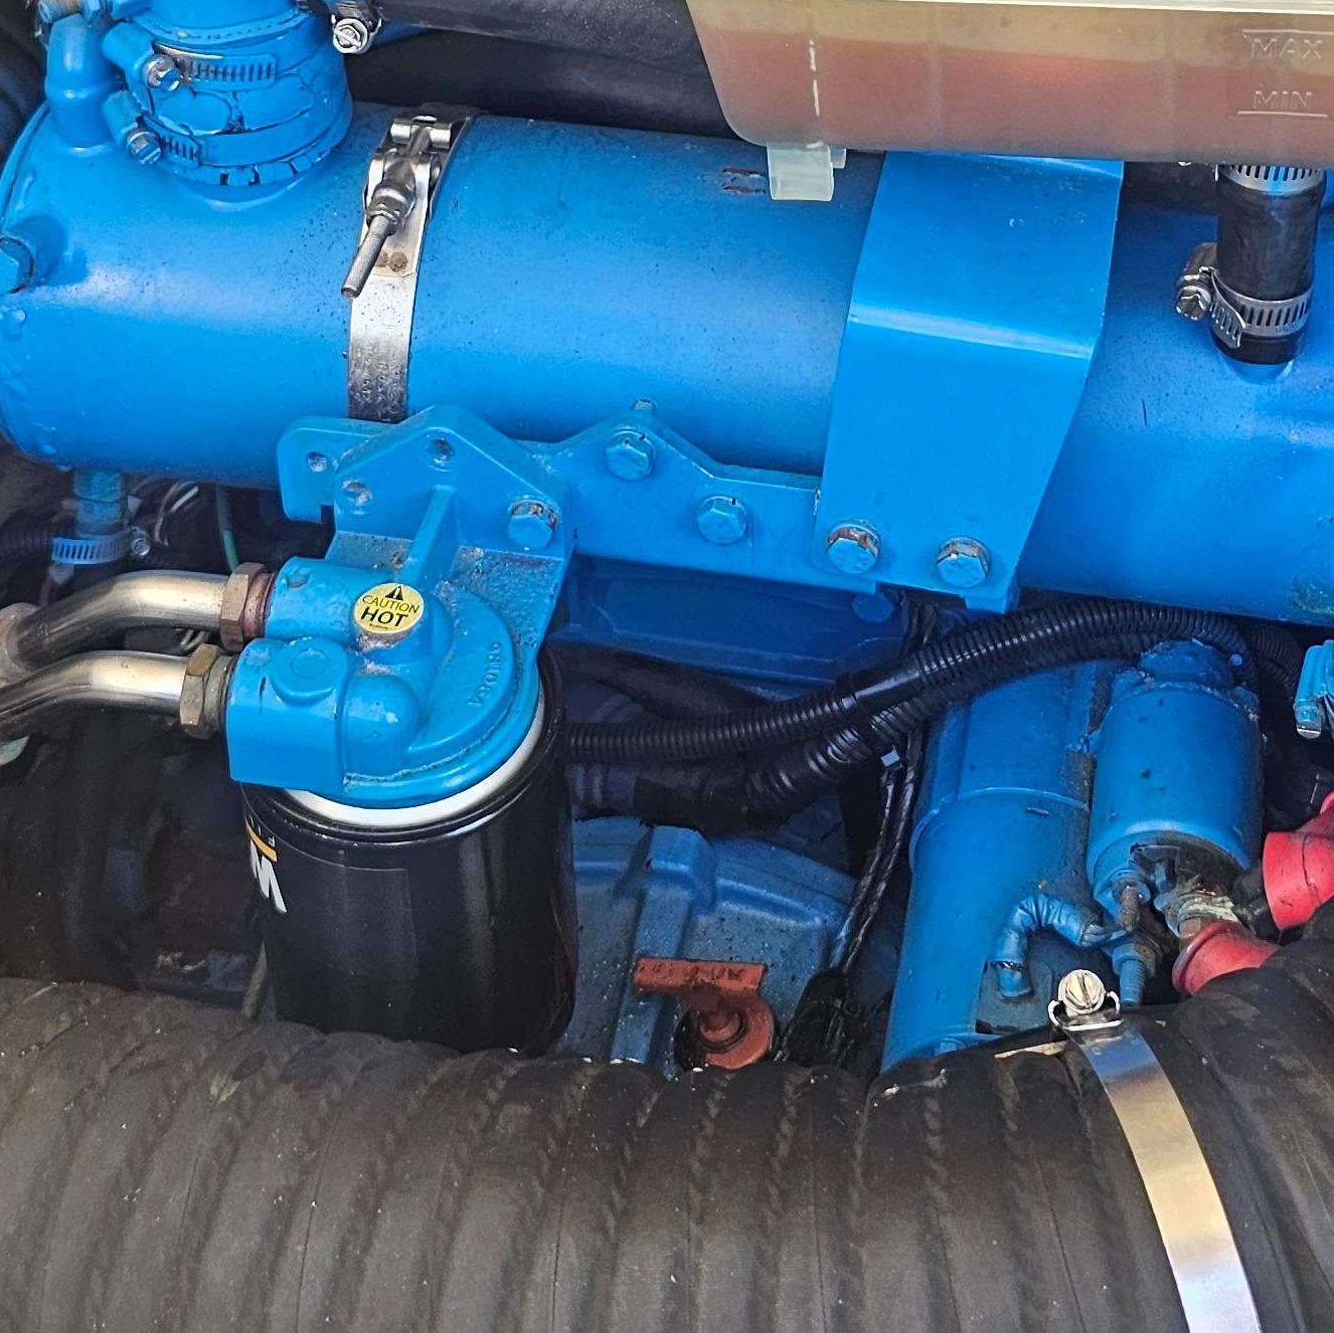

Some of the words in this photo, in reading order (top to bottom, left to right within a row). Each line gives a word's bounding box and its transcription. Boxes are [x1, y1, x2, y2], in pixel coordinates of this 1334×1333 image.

[1250, 37, 1323, 60] MAX
[1253, 90, 1313, 109] MIN
[362, 594, 420, 614] CAUTION
[360, 606, 409, 627] HOT
